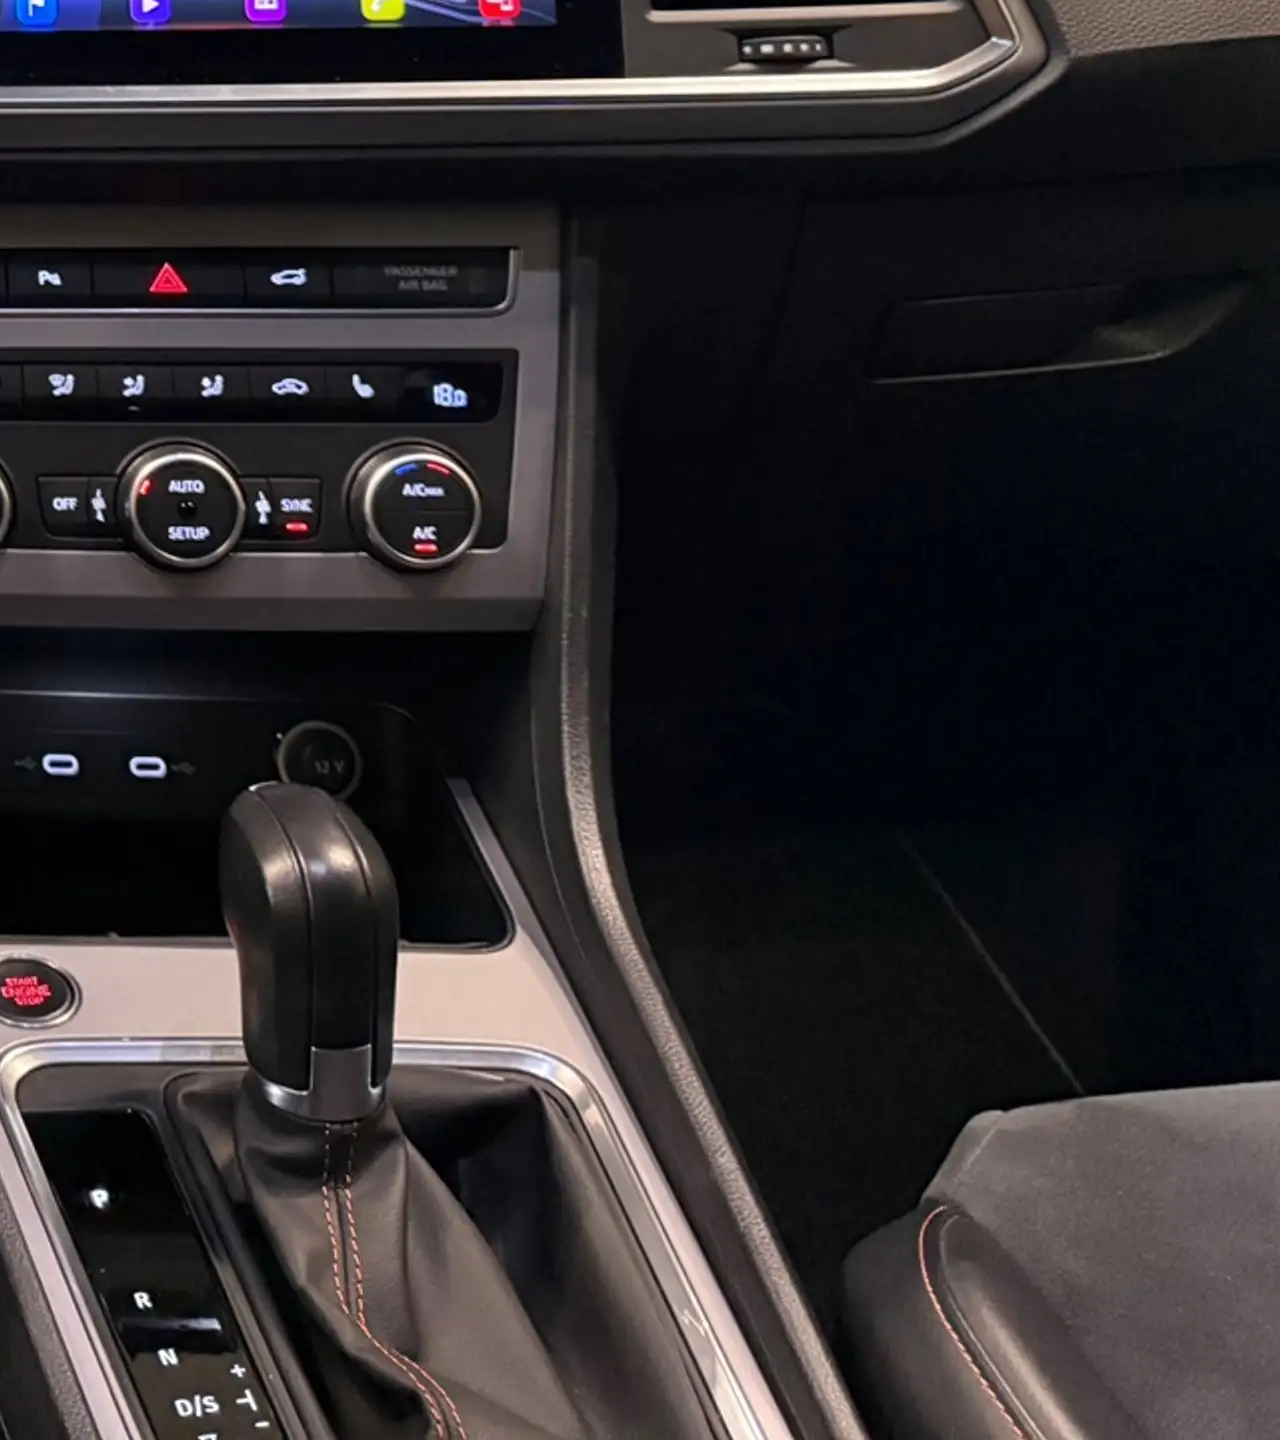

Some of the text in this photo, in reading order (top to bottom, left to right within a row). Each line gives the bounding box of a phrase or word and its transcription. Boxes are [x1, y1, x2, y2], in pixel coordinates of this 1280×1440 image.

[384, 264, 458, 278] PASSENGER
[433, 382, 469, 407] 18.0
[167, 479, 206, 494] AUTO
[51, 497, 78, 512] OFF
[279, 497, 314, 513] SYNC
[167, 525, 211, 541] SETUP
[411, 525, 438, 540] A/C
[89, 1187, 110, 1209] P
[133, 1291, 153, 1310] R
[157, 1347, 180, 1368] N
[173, 1394, 220, 1419] D/S
